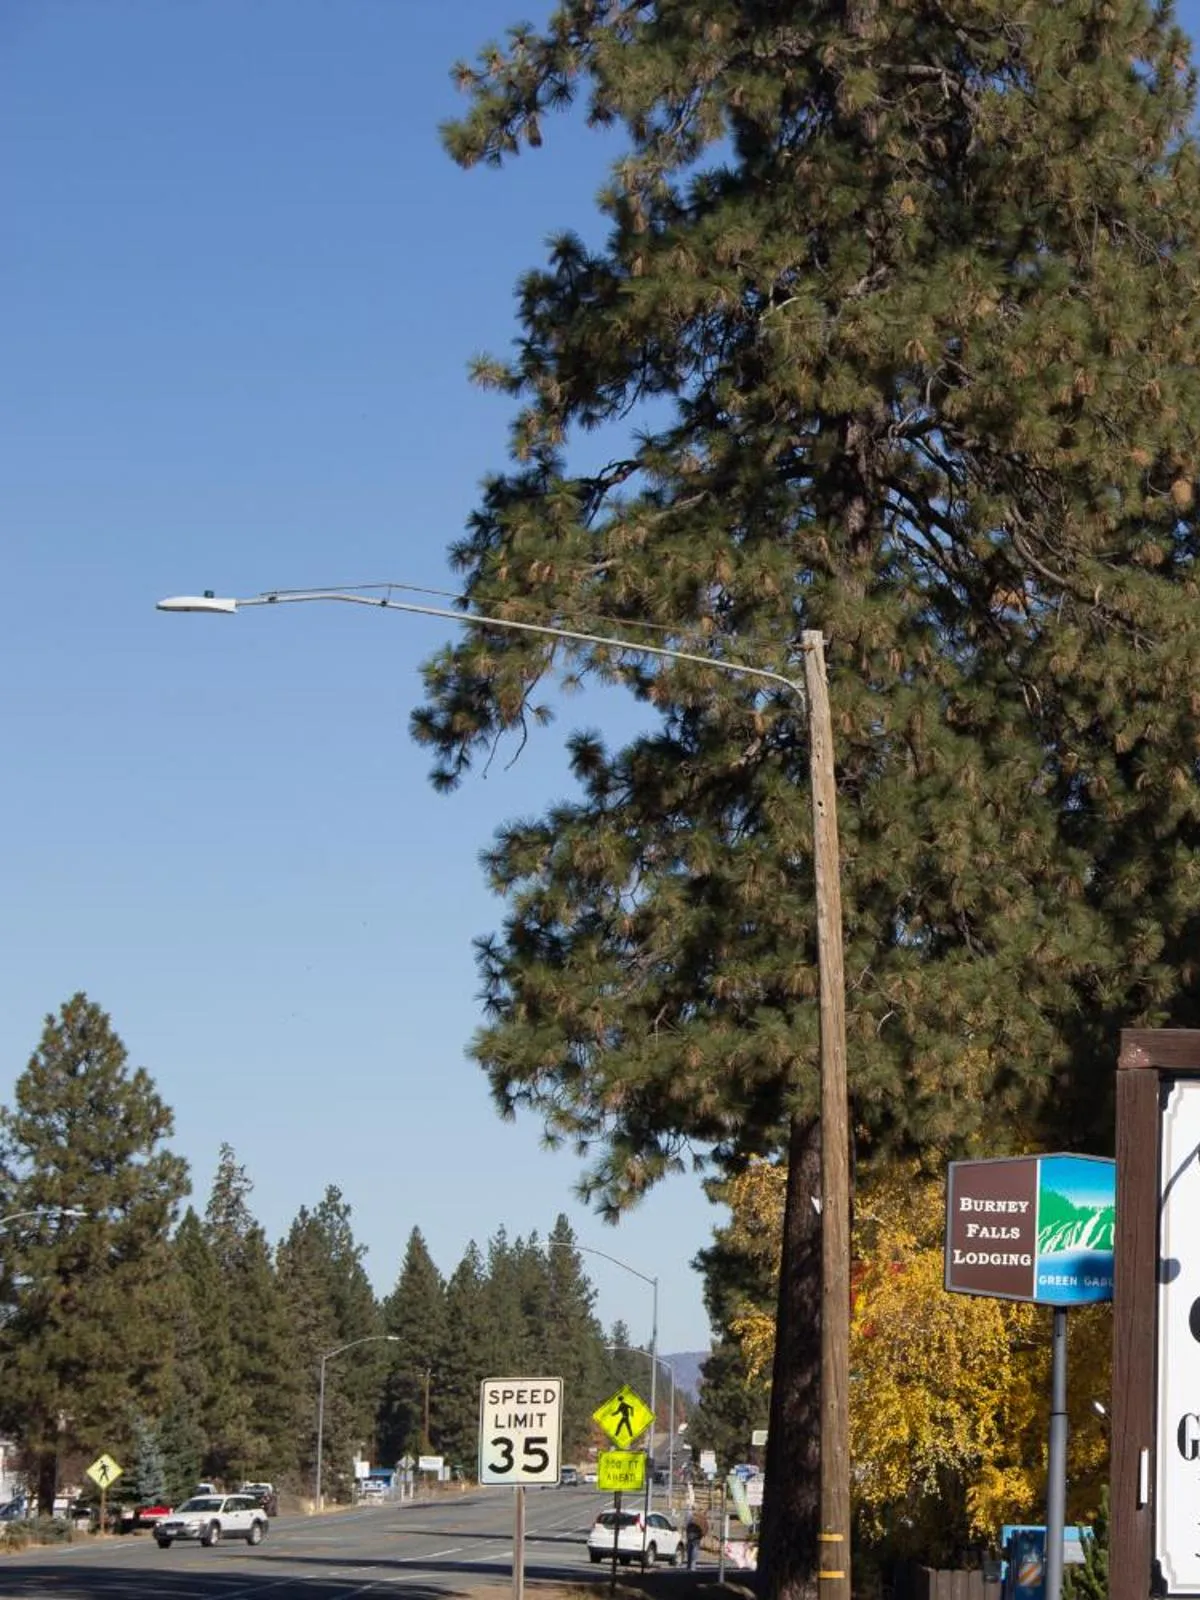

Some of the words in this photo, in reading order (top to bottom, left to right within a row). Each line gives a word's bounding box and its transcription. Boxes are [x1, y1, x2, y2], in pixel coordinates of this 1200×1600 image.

[959, 1197, 1029, 1214] BURNEY
[966, 1224, 1020, 1240] FALLS
[953, 1250, 1032, 1267] LODGING
[1039, 1275, 1078, 1286] GREEN
[488, 1388, 556, 1405] SPEED
[494, 1412, 547, 1428] LIMIT
[488, 1436, 549, 1474] 35
